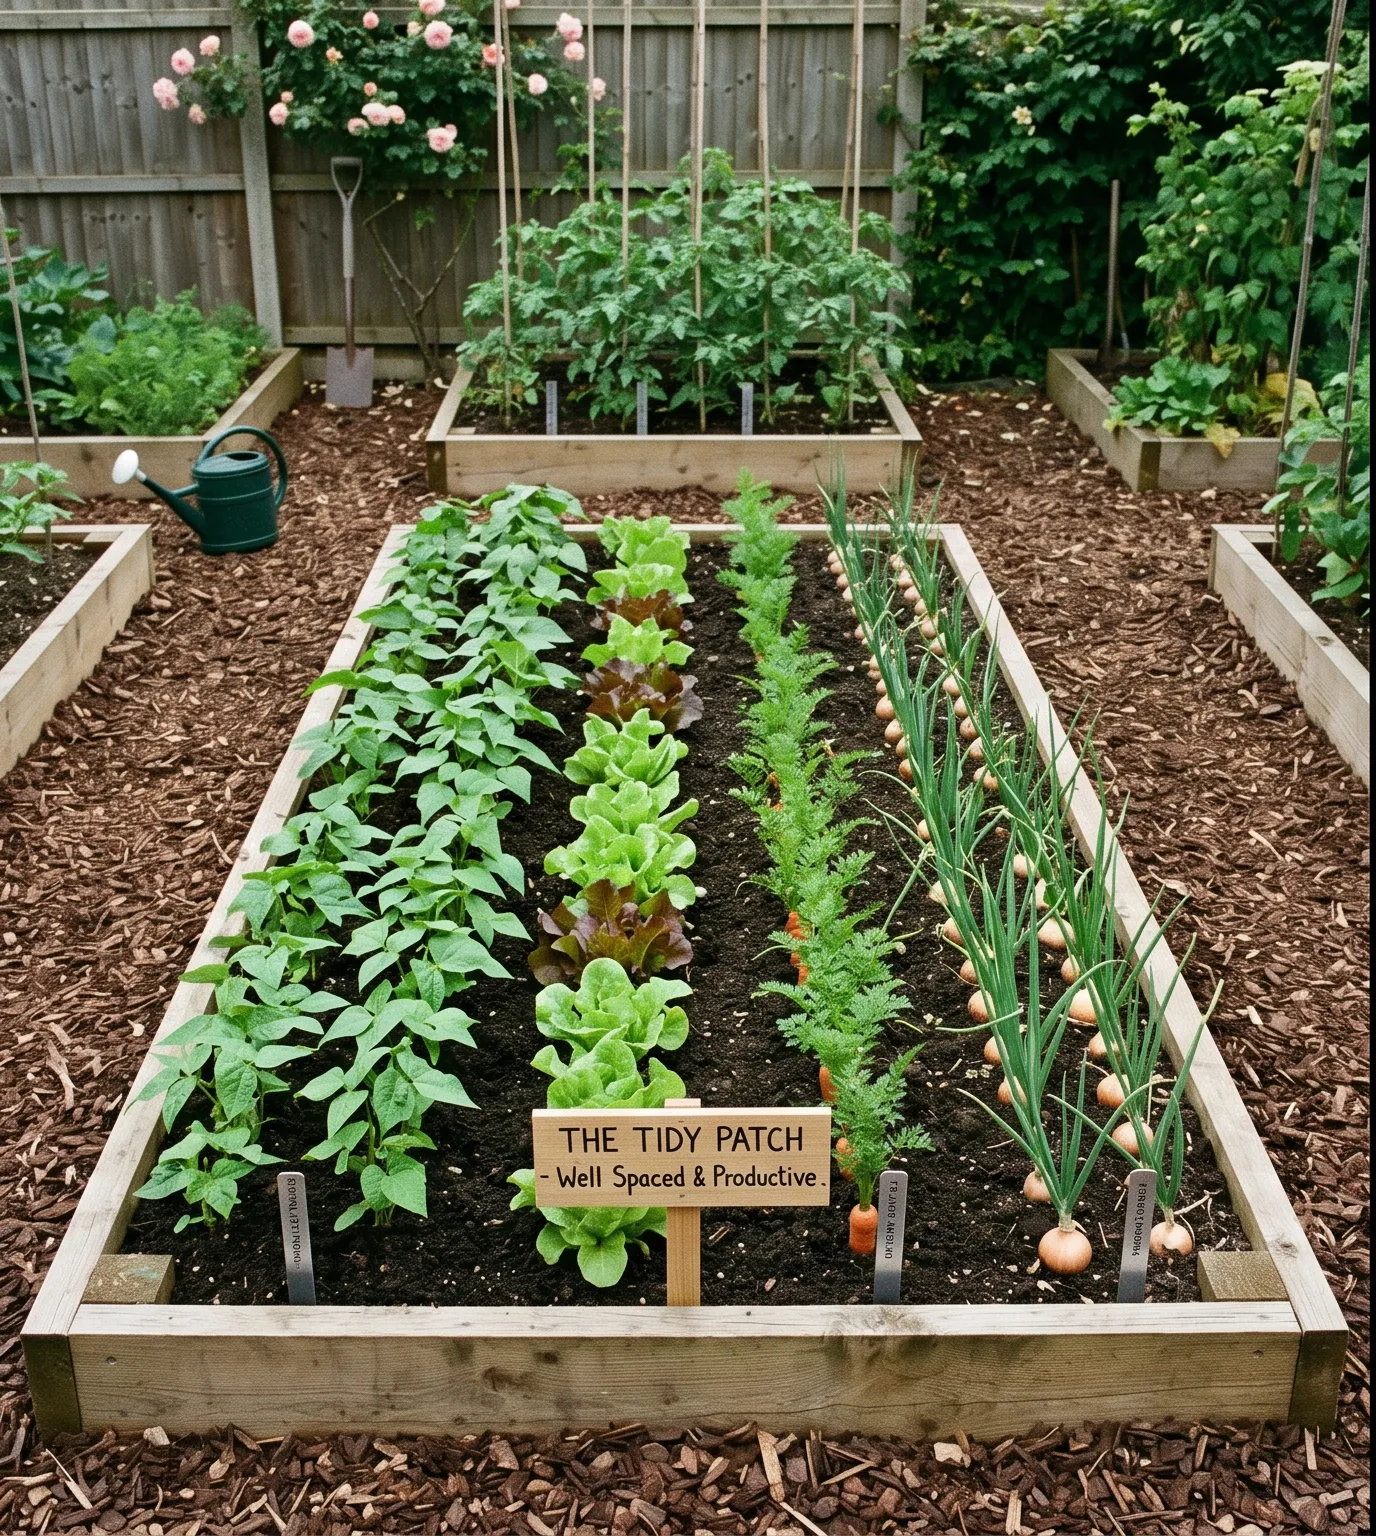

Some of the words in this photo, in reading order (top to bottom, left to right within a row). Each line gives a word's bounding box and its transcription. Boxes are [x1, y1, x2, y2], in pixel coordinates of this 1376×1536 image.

[558, 1126, 619, 1153] THE
[632, 1126, 702, 1153] TIDY
[716, 1126, 804, 1152] PATCH
[556, 1164, 602, 1188] Well
[612, 1164, 686, 1196] Spaced
[693, 1165, 706, 1188] &
